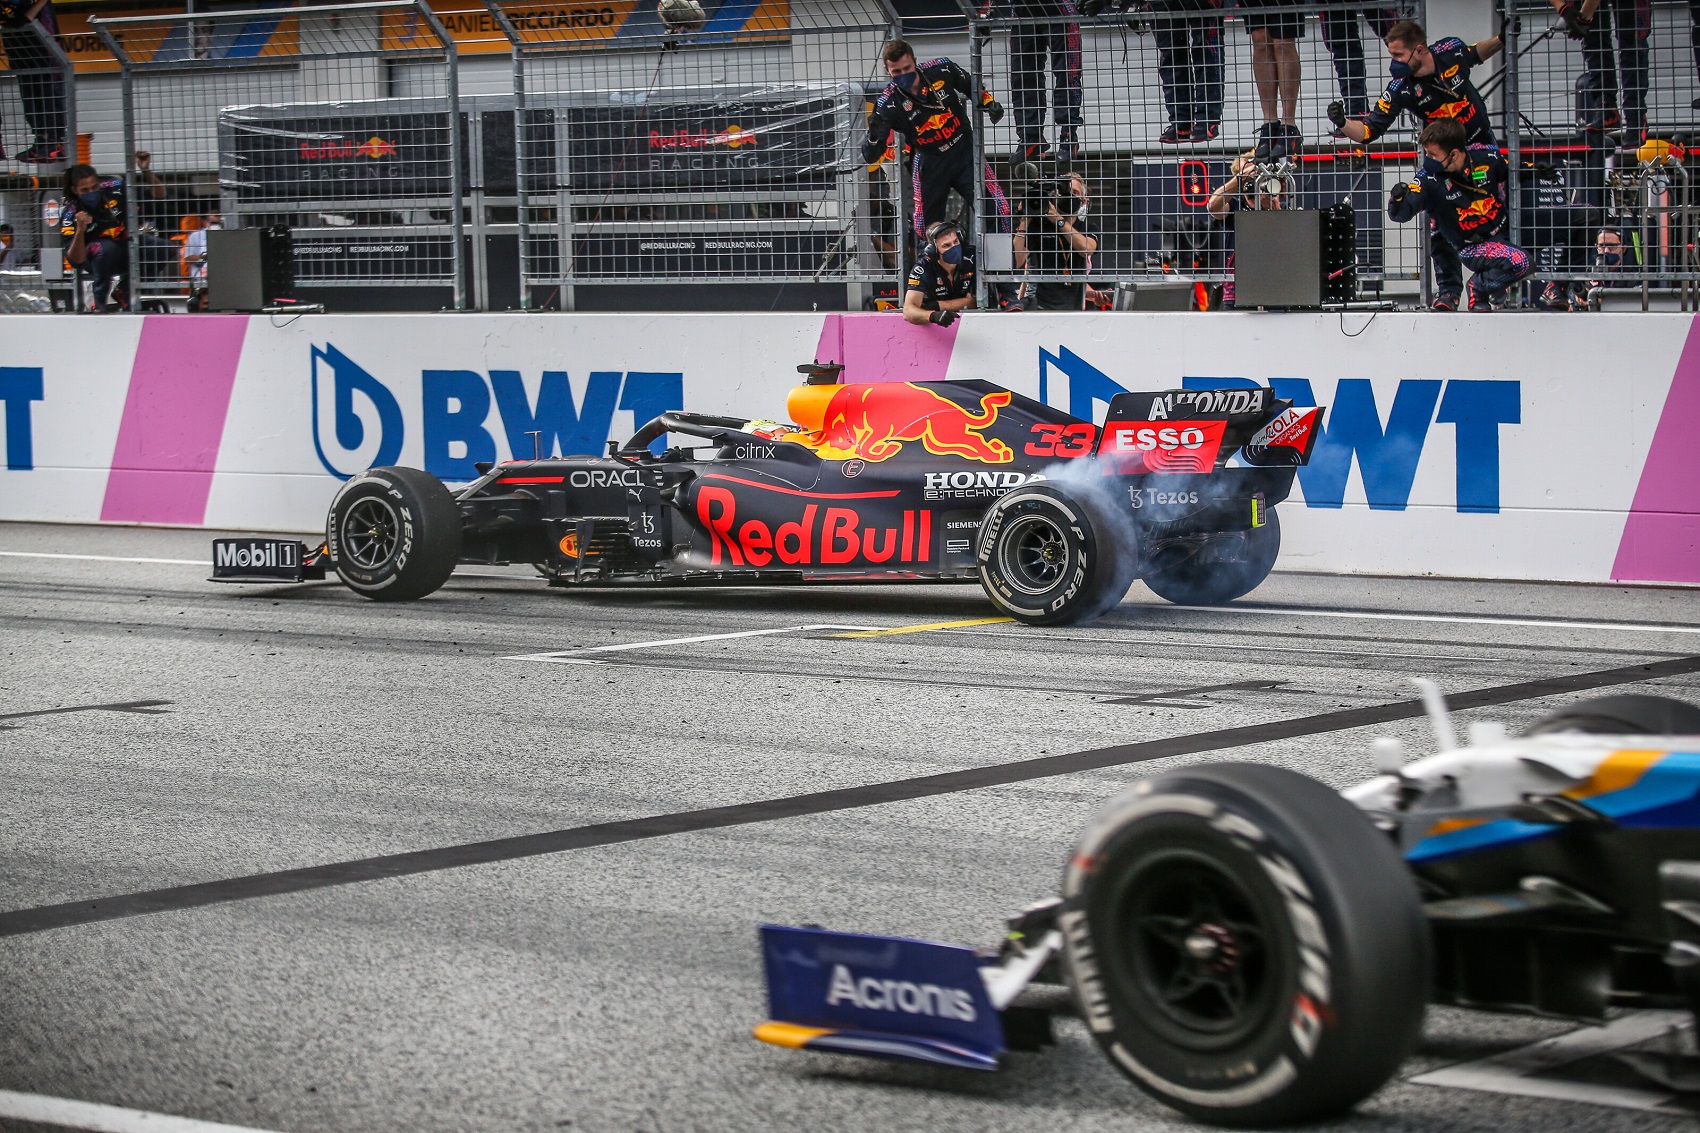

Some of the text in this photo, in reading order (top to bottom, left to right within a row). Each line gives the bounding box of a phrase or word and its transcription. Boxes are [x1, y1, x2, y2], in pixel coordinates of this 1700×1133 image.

[917, 131, 943, 146] Red
[941, 117, 961, 140] Bull
[300, 140, 353, 159] Red Bull
[302, 167, 398, 180] RACING
[422, 370, 684, 481] BWT
[1265, 409, 1300, 438] COLA
[735, 442, 776, 459] citrix
[1024, 423, 1096, 458] 33
[1115, 427, 1205, 451] ESSO
[1147, 487, 1199, 506] Tezos
[396, 506, 414, 571] ZERO
[697, 486, 931, 567] Red Bull
[978, 509, 1005, 562] PIRELLI
[217, 543, 277, 567] Mobil
[633, 536, 662, 548] Tezos
[1052, 526, 1087, 612] P ZERO
[825, 963, 978, 1023] Acronis
